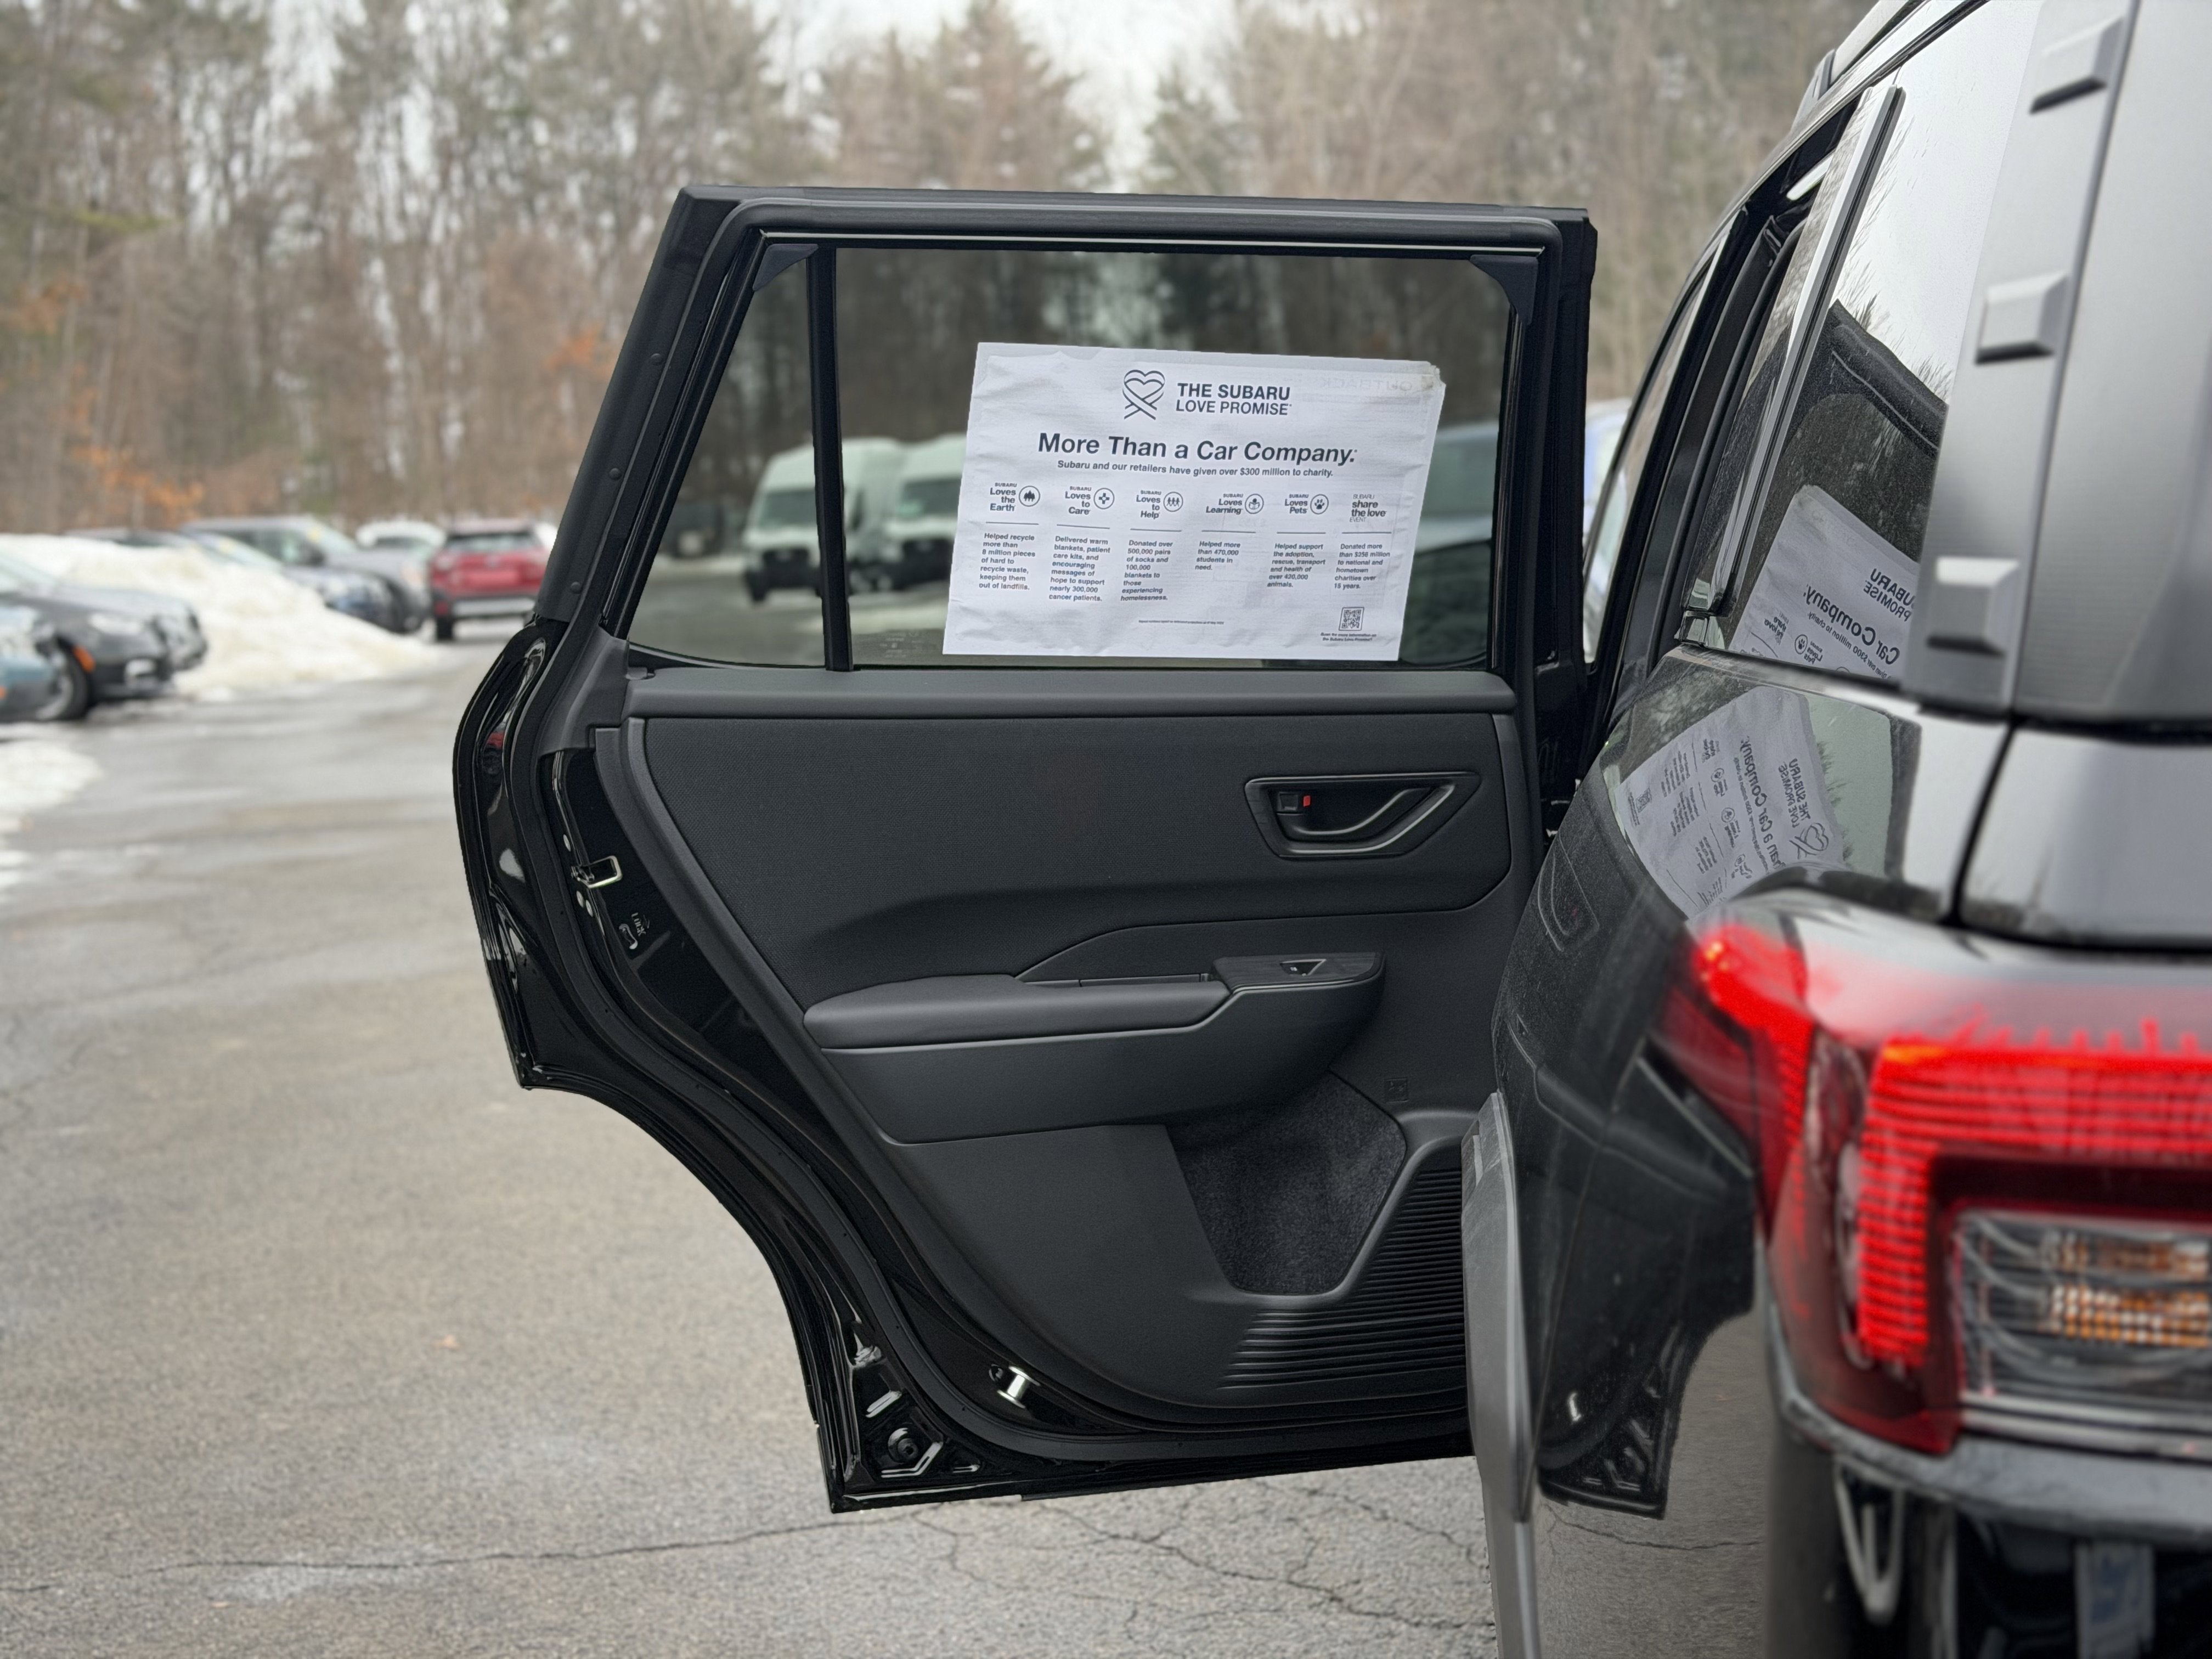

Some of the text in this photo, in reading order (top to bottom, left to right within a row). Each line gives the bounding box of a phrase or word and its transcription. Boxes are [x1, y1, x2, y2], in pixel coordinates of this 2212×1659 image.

[1177, 383, 1290, 401] THE SUBARU
[1176, 399, 1215, 413] LOVE
[1038, 432, 1099, 453] More
[1108, 436, 1167, 457] Than
[1174, 444, 1188, 459] a
[1197, 441, 1238, 460] Car
[1057, 460, 1091, 469] Subaru
[1092, 462, 1109, 470] and
[1130, 464, 1166, 473] retailers
[1170, 465, 1190, 474] have
[1193, 467, 1217, 477] given
[1240, 467, 1260, 476] $300
[1262, 468, 1290, 476] million
[1303, 469, 1333, 477] charity.
[1065, 491, 1091, 499] Loves
[1136, 495, 1161, 503] Loves
[1352, 500, 1378, 509] share
[1054, 544, 1085, 552] blankets,
[1052, 561, 1096, 569] encouraging
[1077, 578, 1105, 586] support
